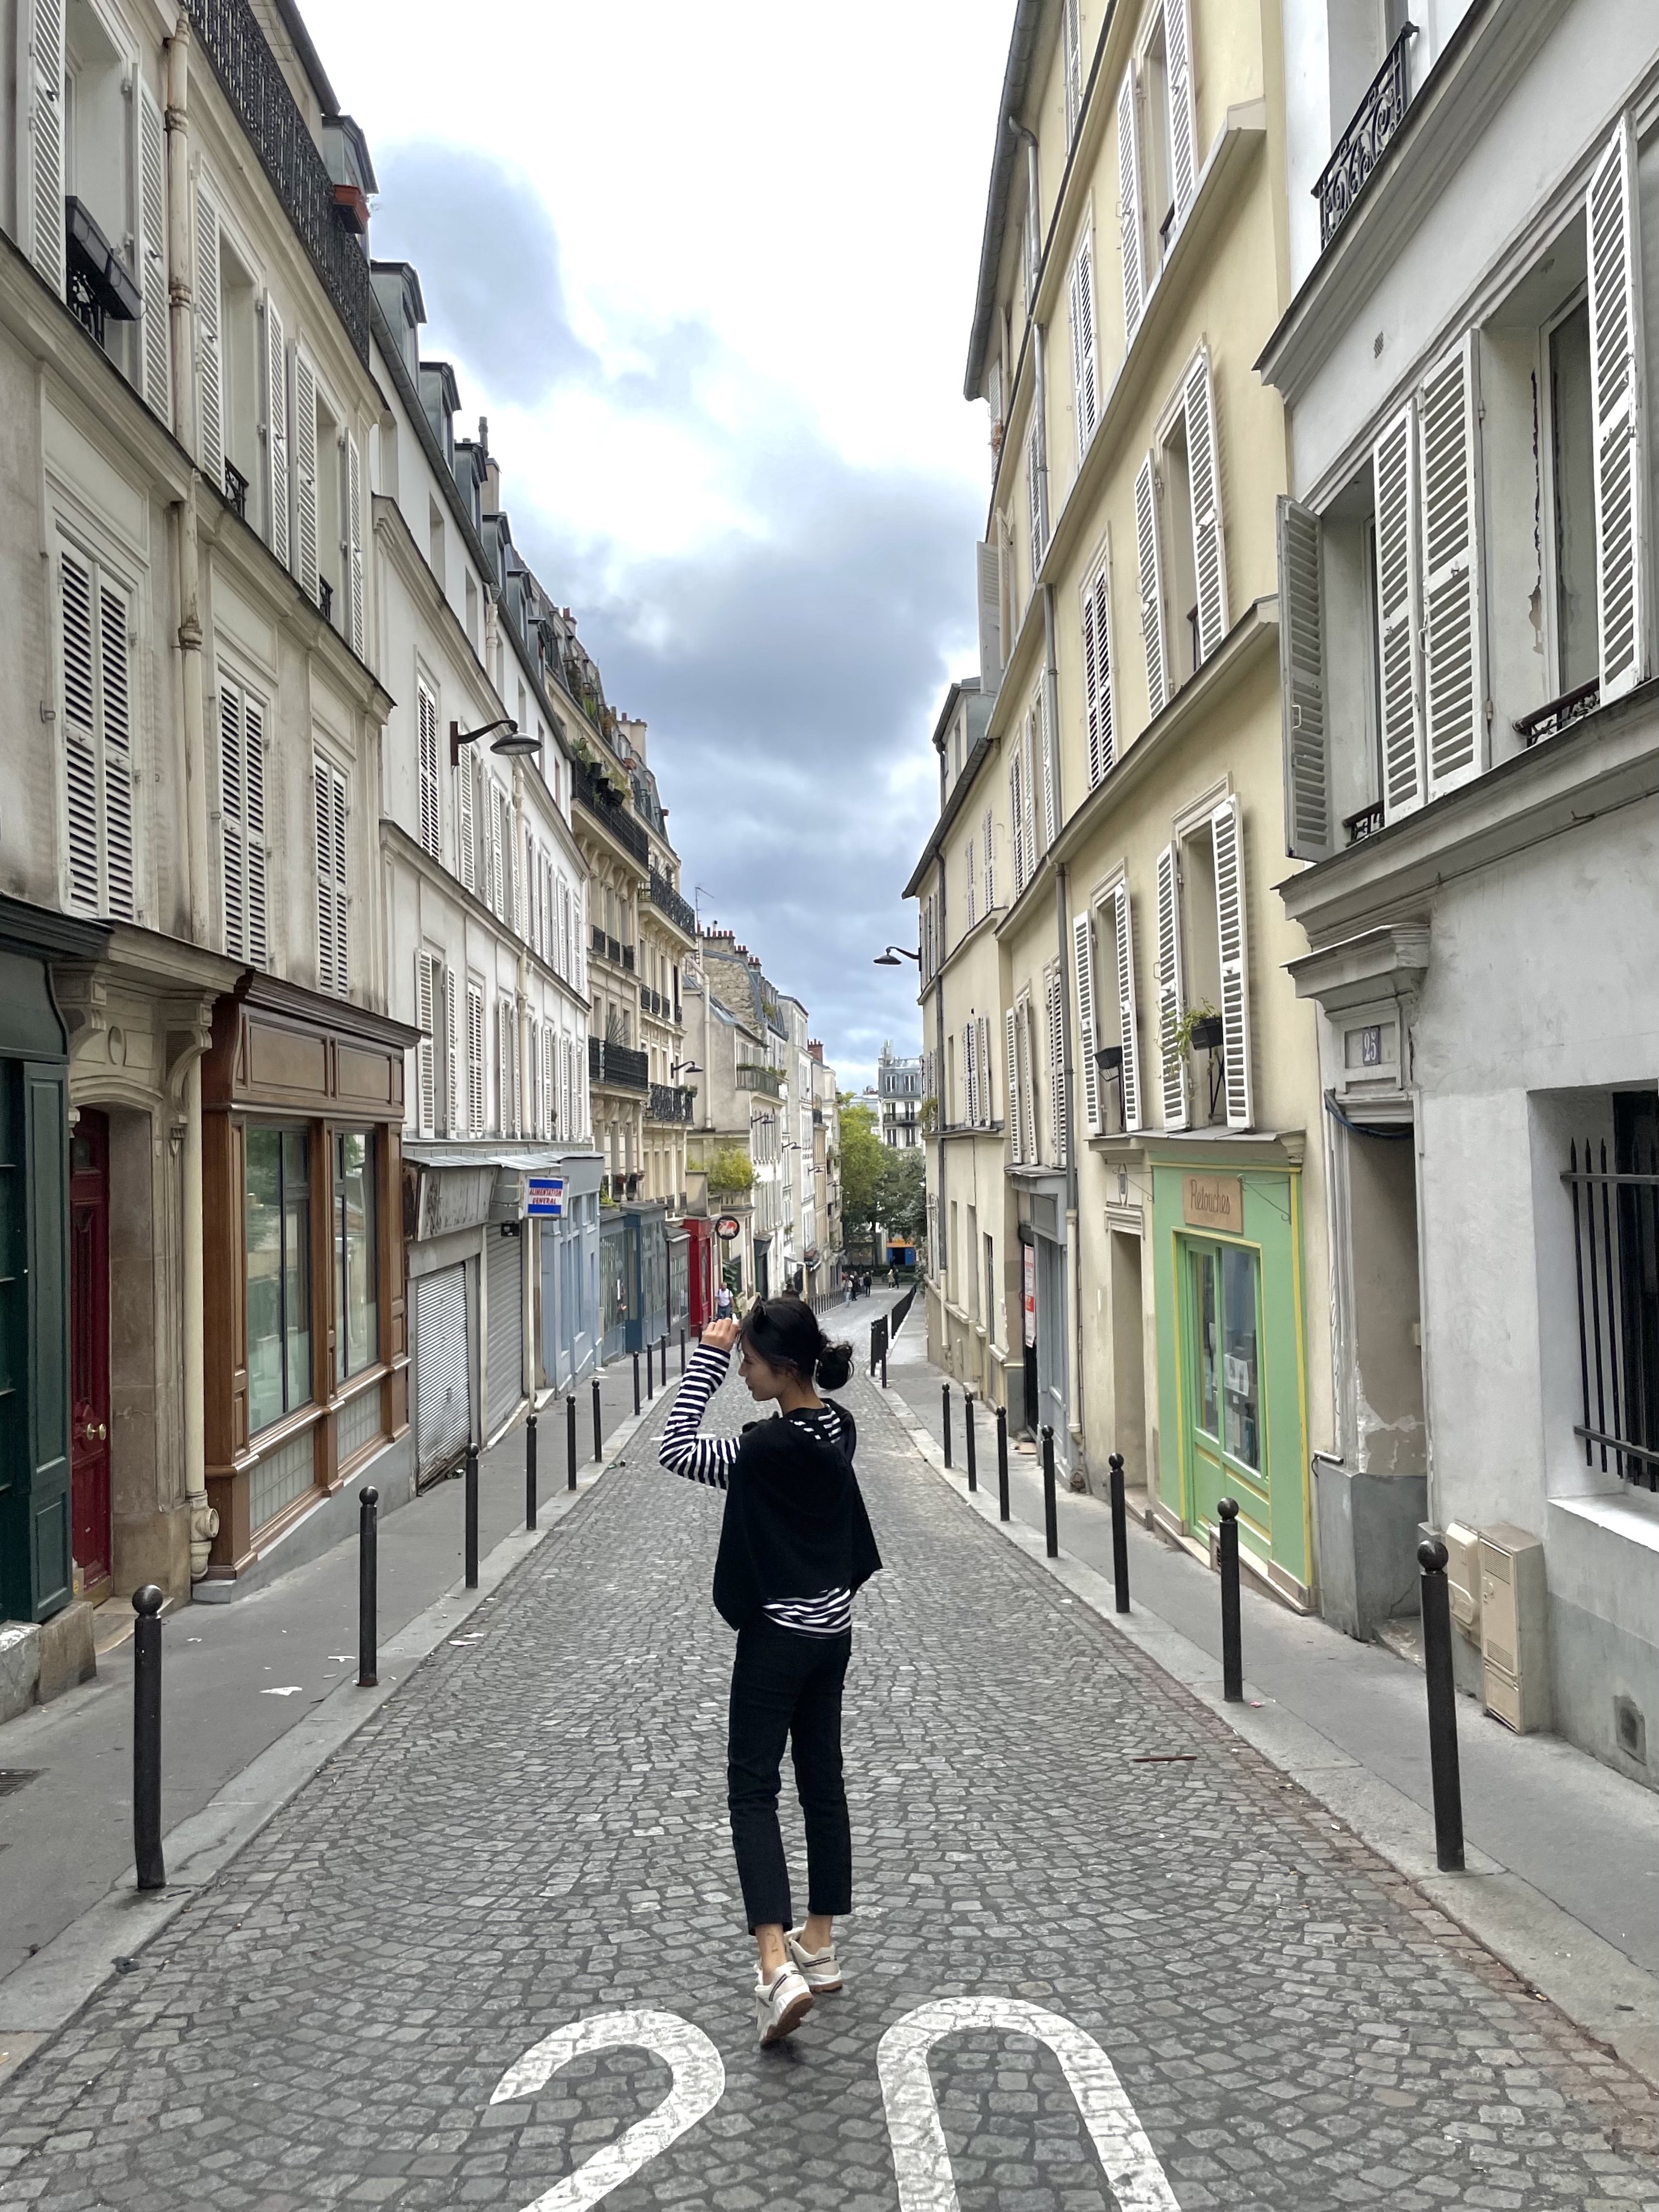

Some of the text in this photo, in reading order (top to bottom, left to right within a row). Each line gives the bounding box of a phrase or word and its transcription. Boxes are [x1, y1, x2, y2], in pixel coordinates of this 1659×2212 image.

[1364, 1031, 1376, 1061] 25
[530, 1188, 561, 1197] ALIMENTATION
[1190, 1179, 1230, 1215] Retouches
